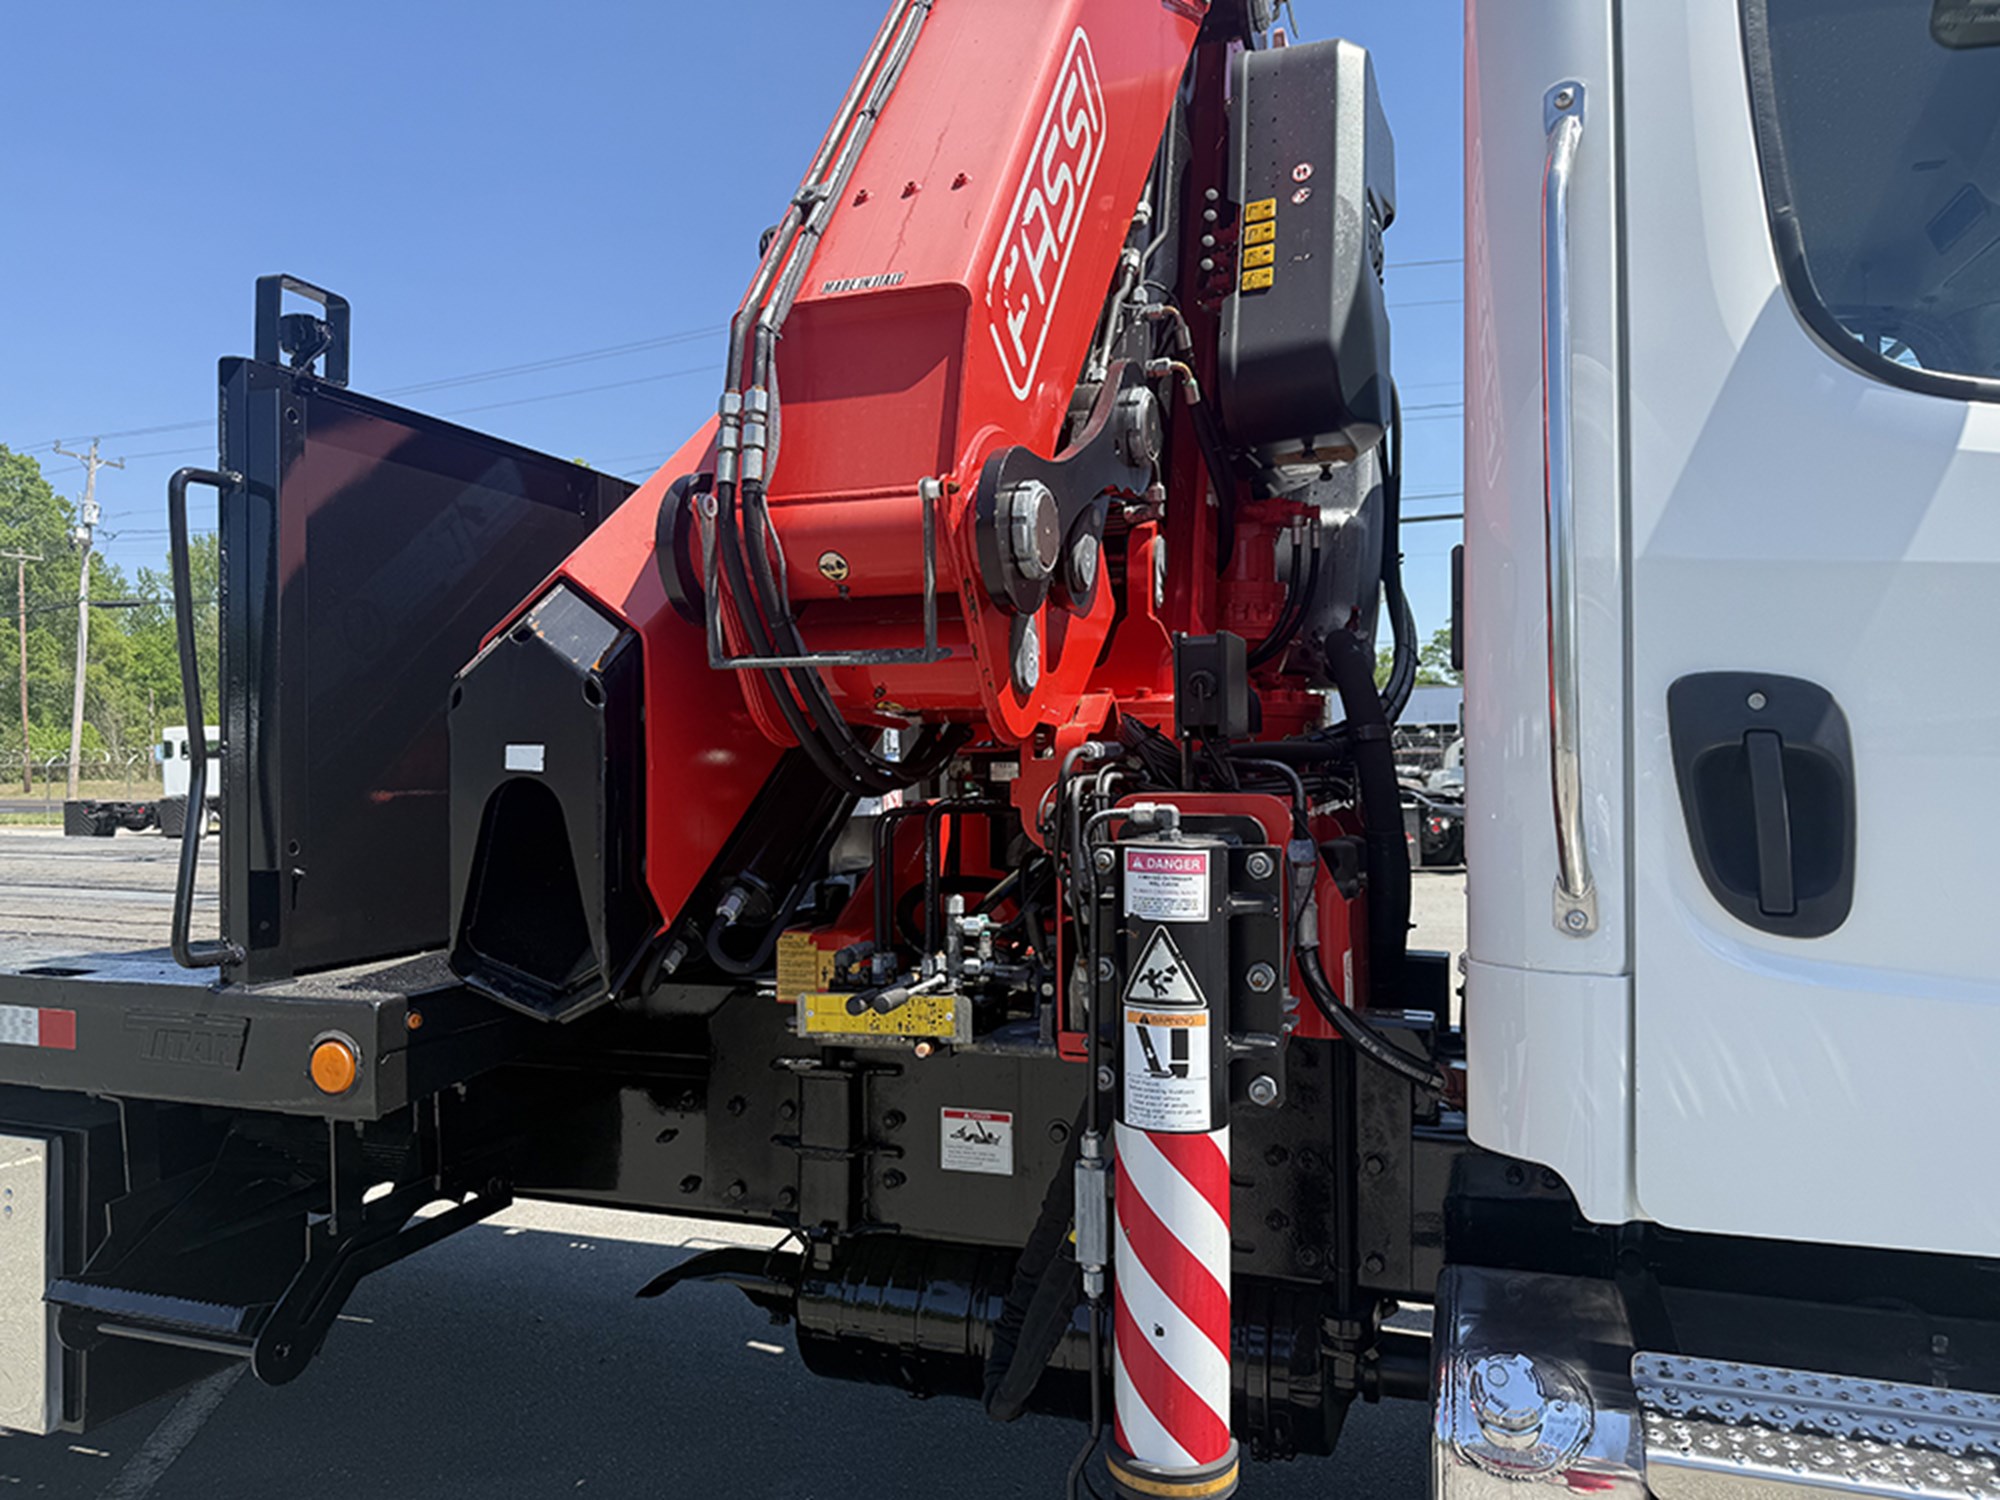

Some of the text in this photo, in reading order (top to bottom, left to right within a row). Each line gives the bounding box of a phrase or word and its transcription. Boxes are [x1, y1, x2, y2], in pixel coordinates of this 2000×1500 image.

[1003, 55, 1099, 368] FASSI
[823, 272, 905, 294] MADE IN ITALY
[1146, 857, 1201, 871] DANGER
